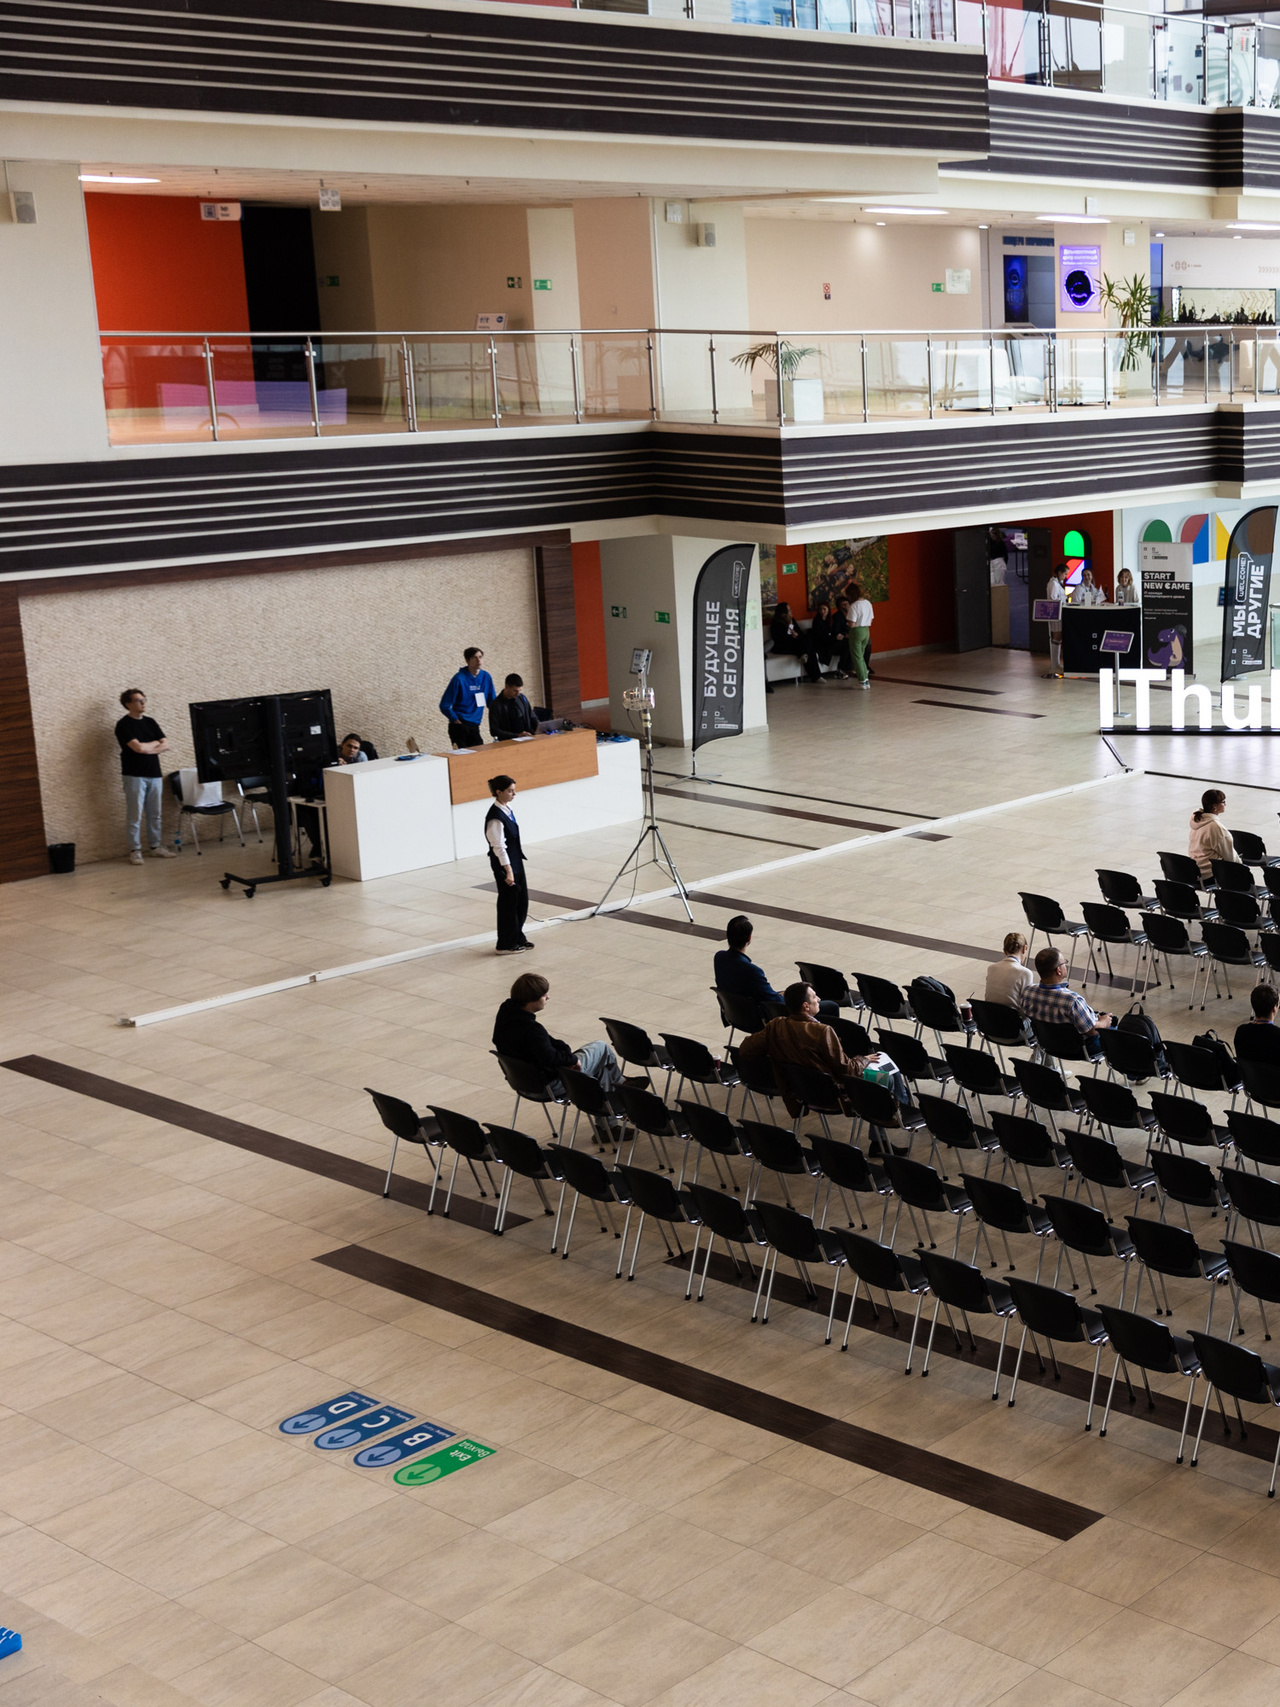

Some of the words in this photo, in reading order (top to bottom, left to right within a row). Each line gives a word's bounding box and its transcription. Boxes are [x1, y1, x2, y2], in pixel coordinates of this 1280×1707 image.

[1247, 565, 1264, 639] ДРУГИЕ
[1233, 605, 1246, 637] МЫ
[704, 601, 721, 698] БУДУЩЕЕ
[723, 608, 740, 698] СЕГОДНЯ
[328, 1401, 358, 1415] D
[362, 1415, 390, 1428] C
[402, 1433, 432, 1446] B
[449, 1450, 472, 1461] Exit
[459, 1441, 490, 1458] Выход
